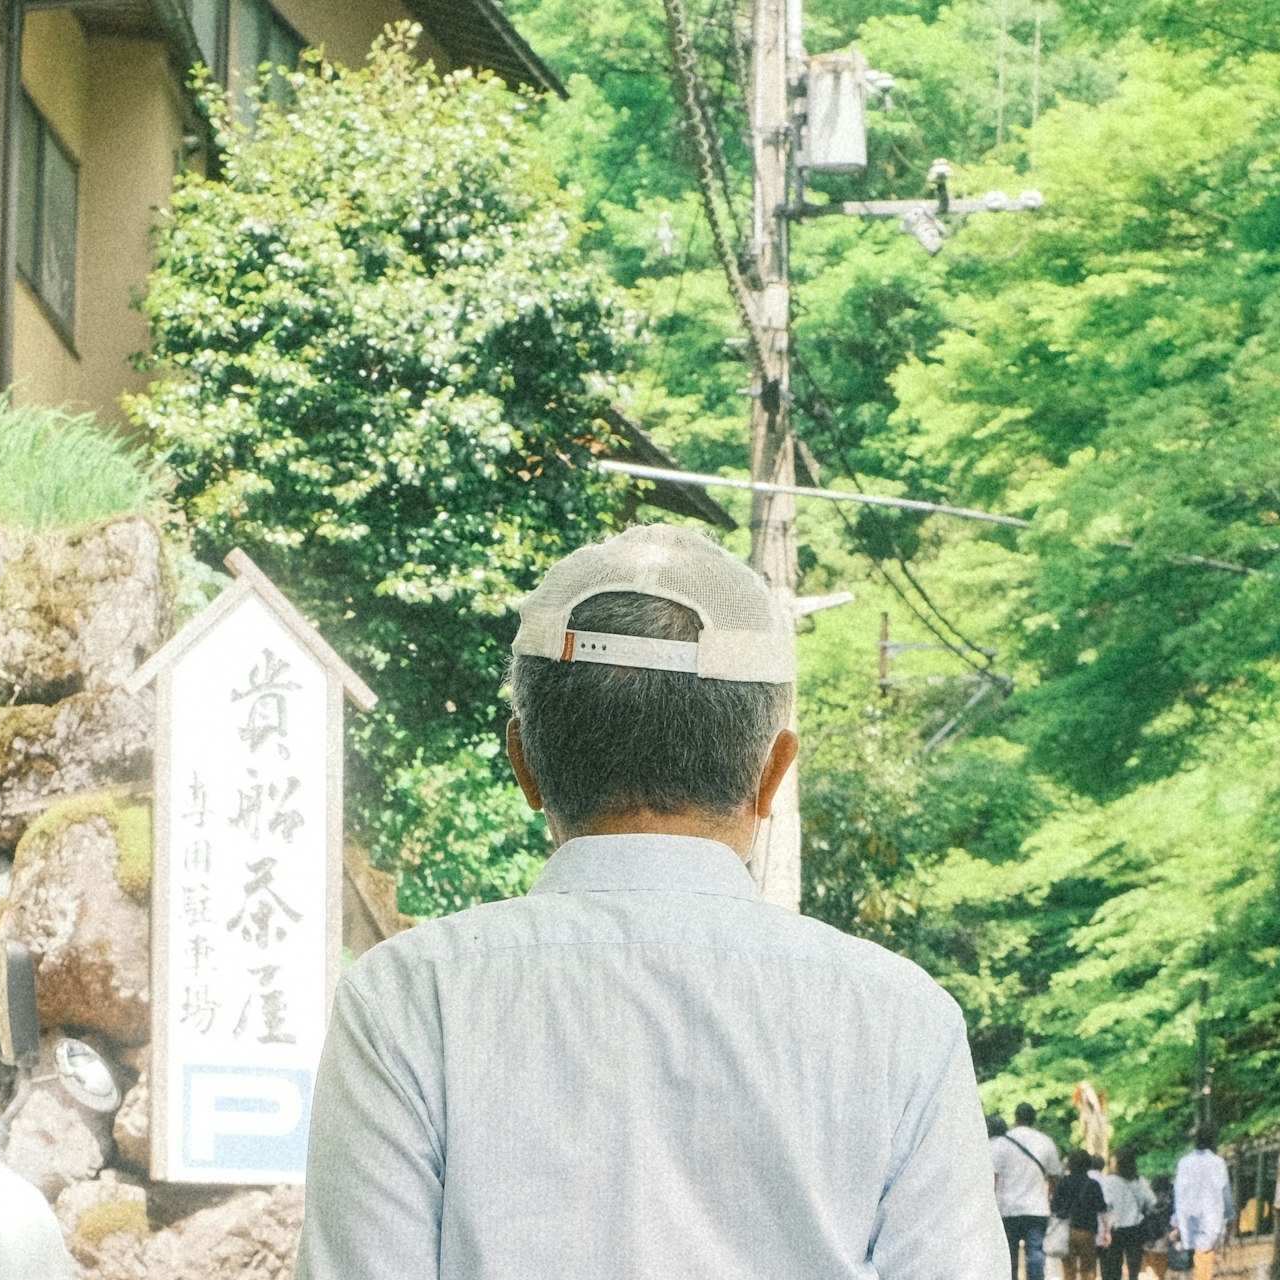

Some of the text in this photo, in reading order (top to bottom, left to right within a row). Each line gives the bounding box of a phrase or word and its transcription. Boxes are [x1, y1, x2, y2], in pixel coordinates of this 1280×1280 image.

[226, 648, 305, 1045] 貴船茶屋
[192, 1074, 303, 1161] P
